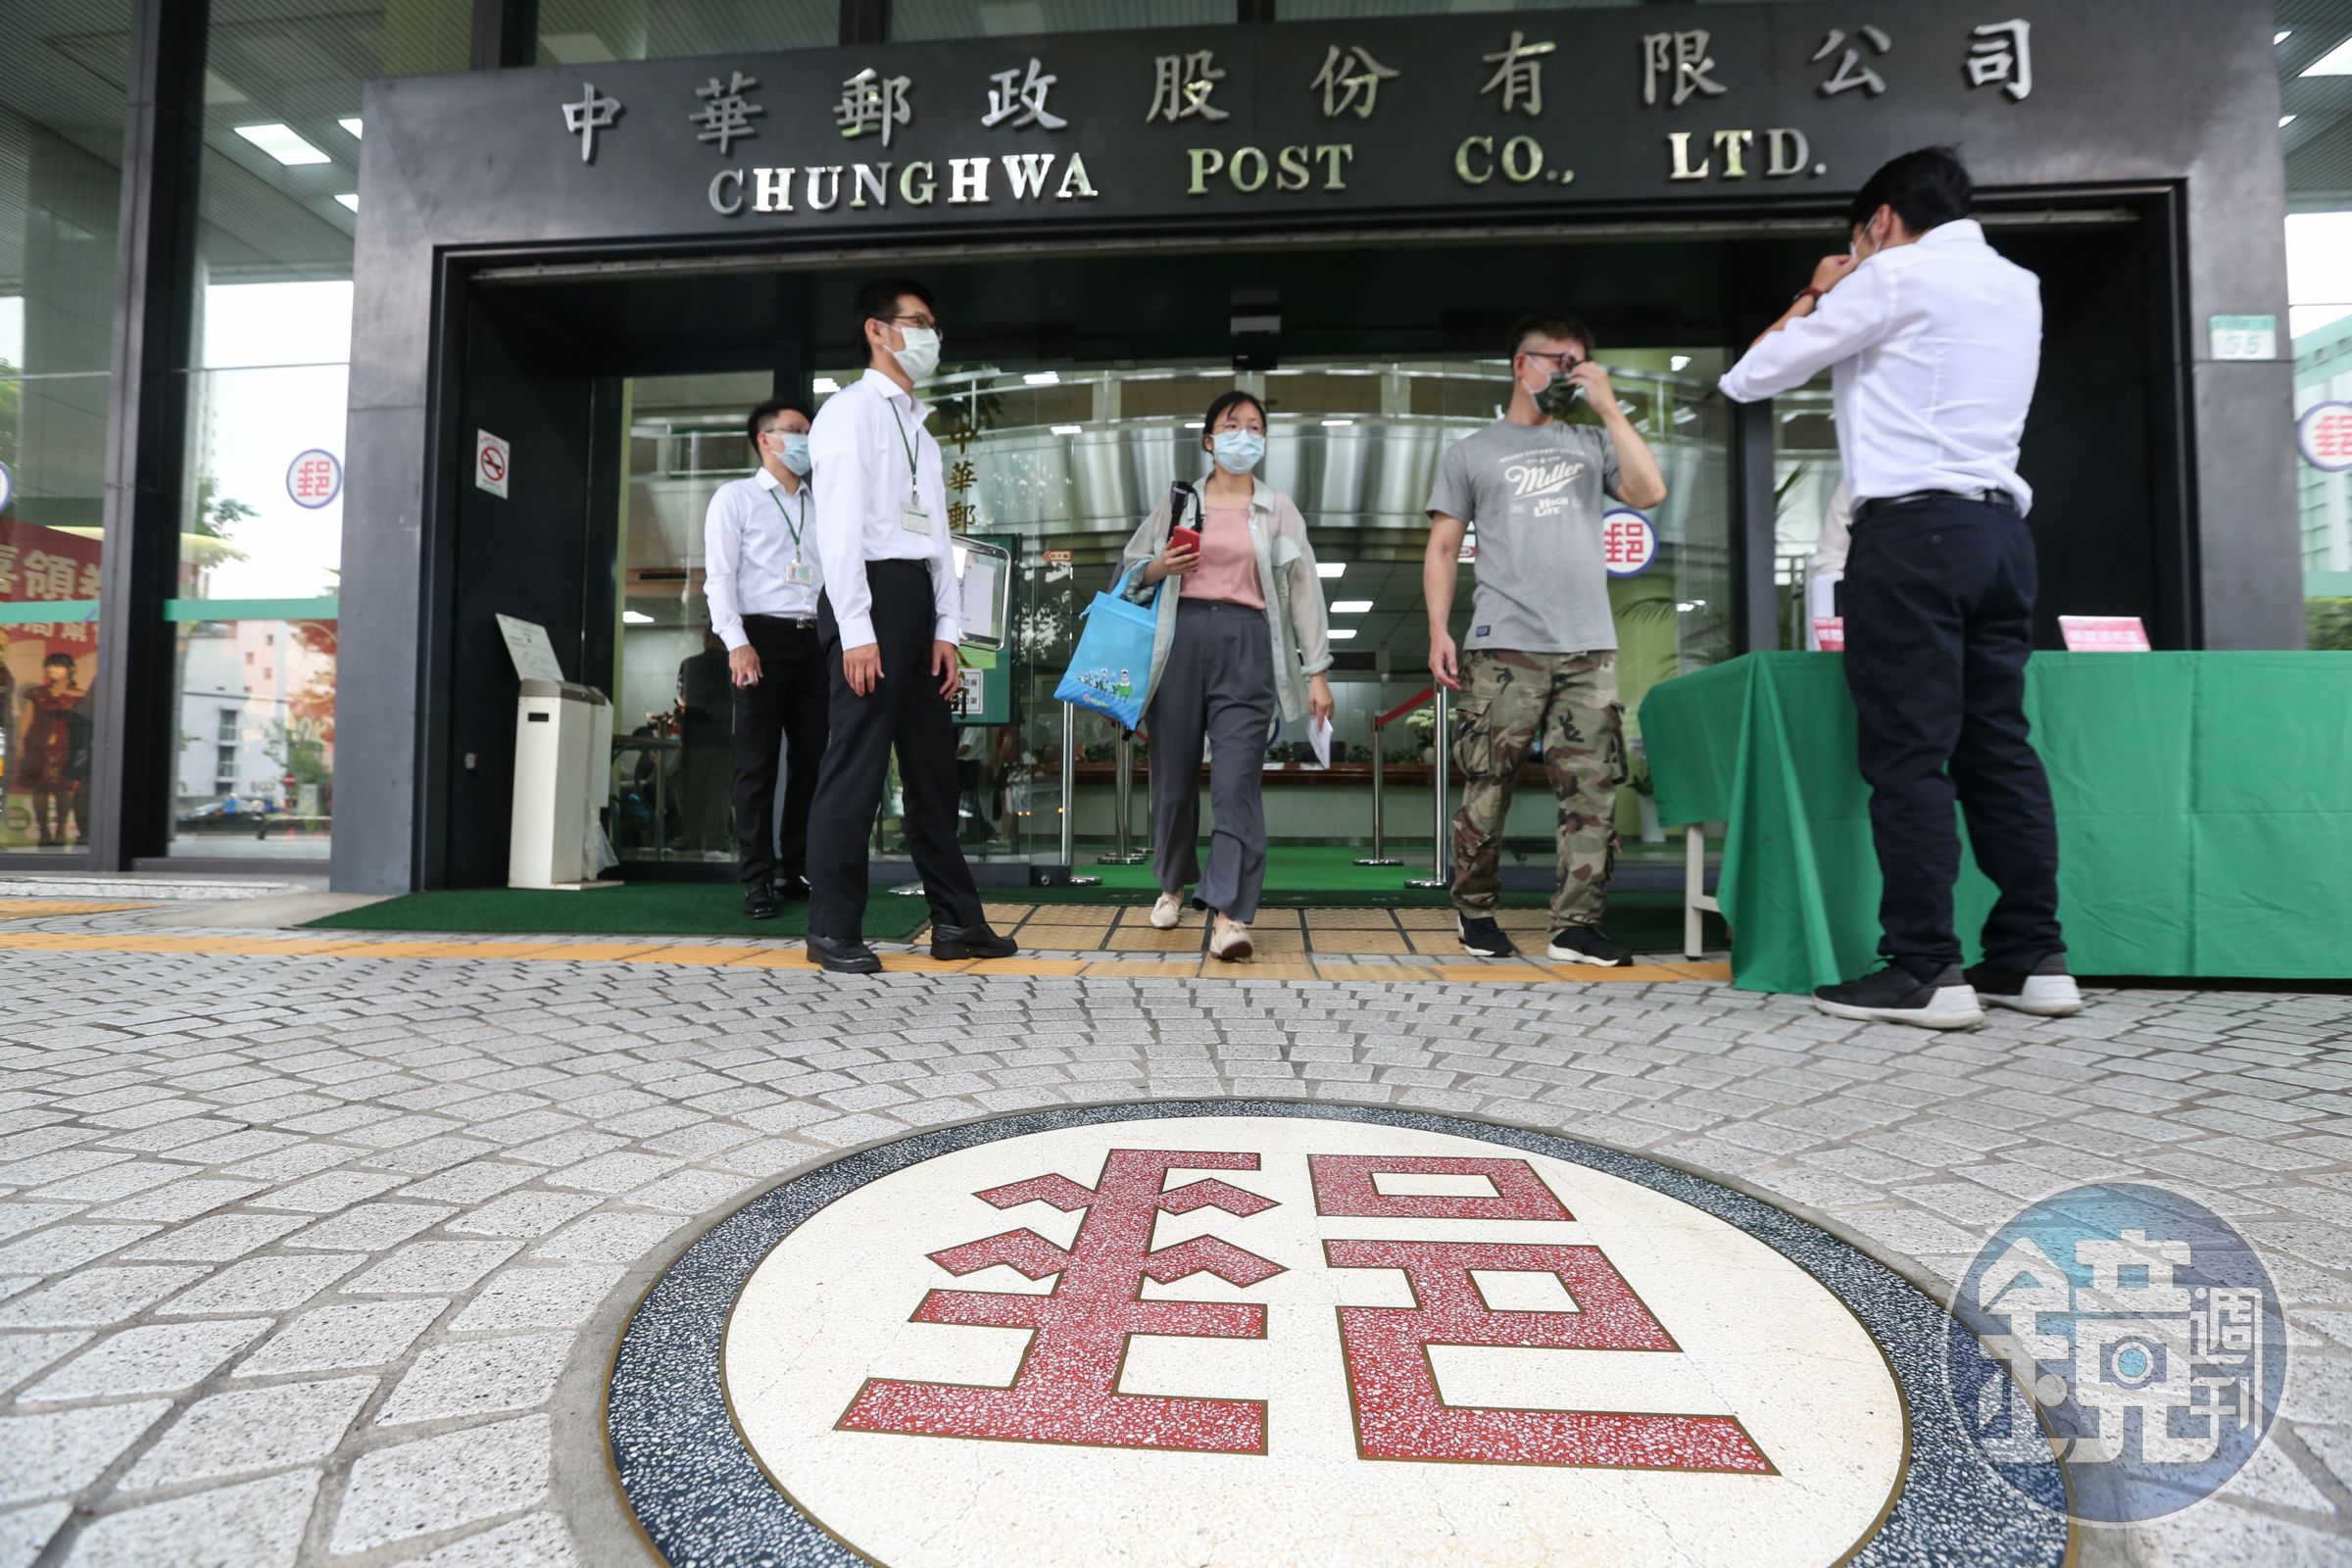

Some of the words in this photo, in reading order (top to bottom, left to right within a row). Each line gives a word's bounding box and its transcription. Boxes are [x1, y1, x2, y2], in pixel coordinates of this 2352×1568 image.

[561, 18, 2032, 163] 中華郵政股份有限公司
[708, 152, 1099, 215] CHUNGHWA
[1186, 143, 1354, 194] POST
[1667, 127, 1827, 180] LTD.
[1504, 462, 1585, 497] Miller
